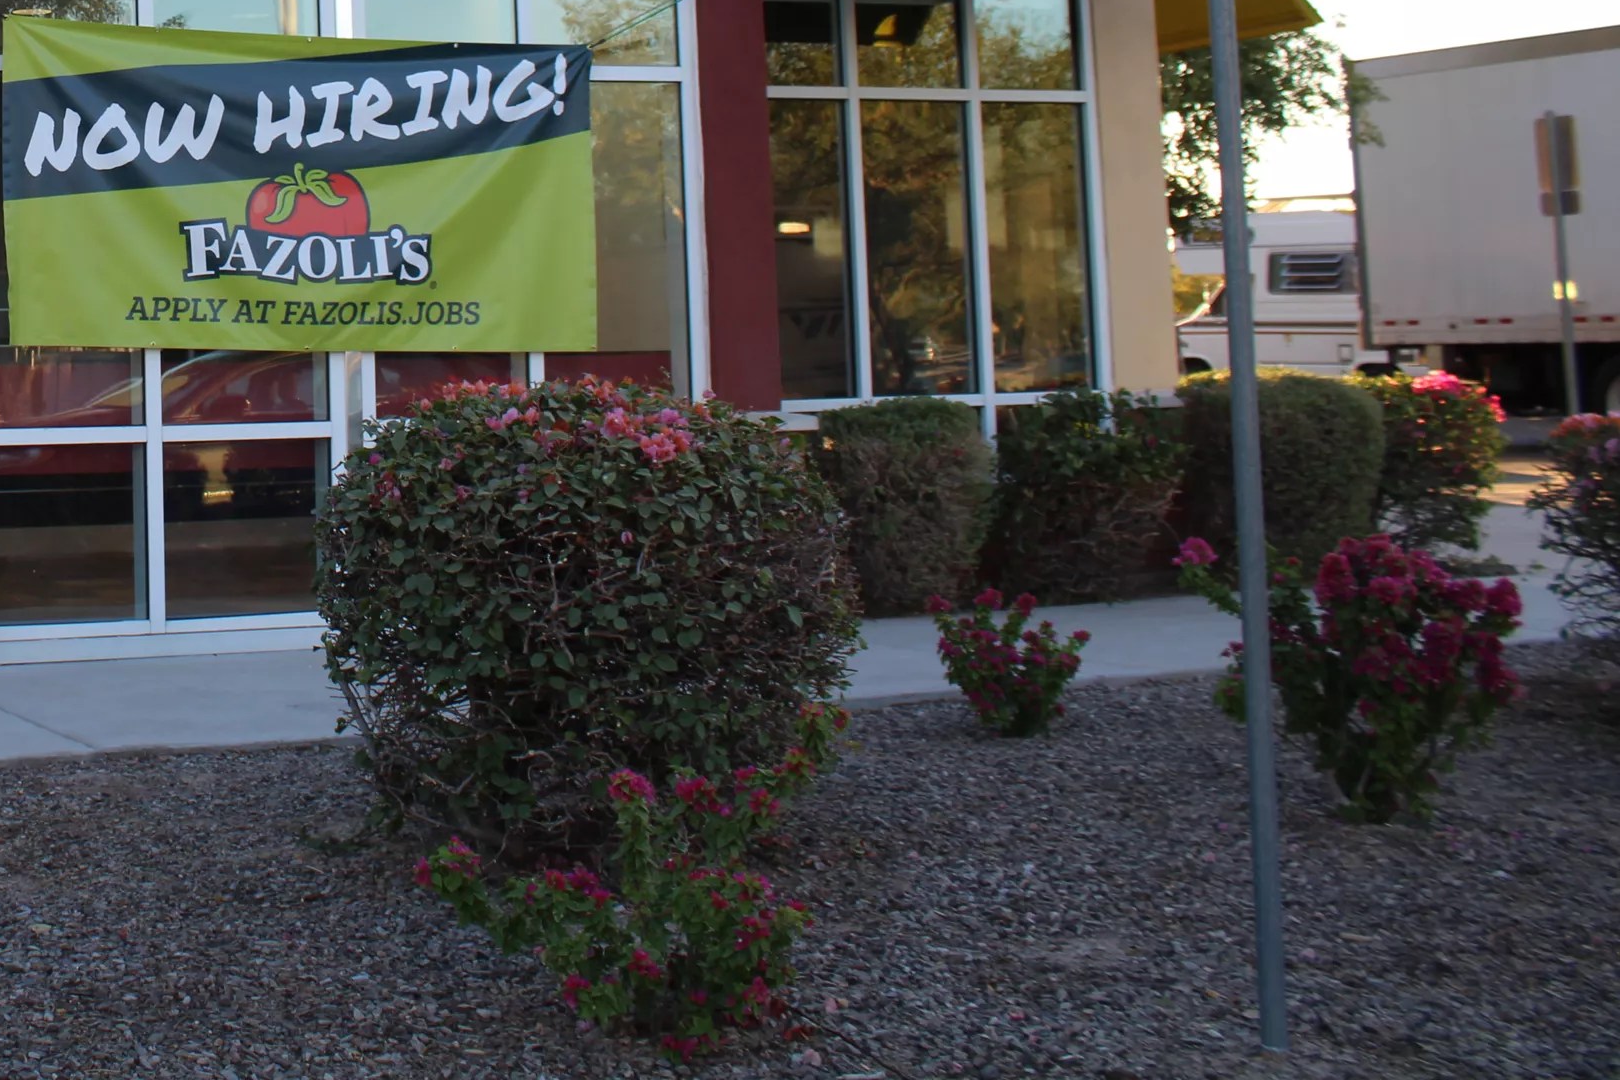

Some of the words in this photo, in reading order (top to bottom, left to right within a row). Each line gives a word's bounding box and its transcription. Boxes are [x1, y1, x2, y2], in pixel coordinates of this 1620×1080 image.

[23, 93, 225, 177] NOW
[252, 52, 568, 156] HIRING!
[182, 220, 431, 283] FAZOLI'S
[125, 296, 228, 323] APPLY
[231, 299, 277, 325] AT
[280, 300, 481, 327] FAZOLIS.JOBS
